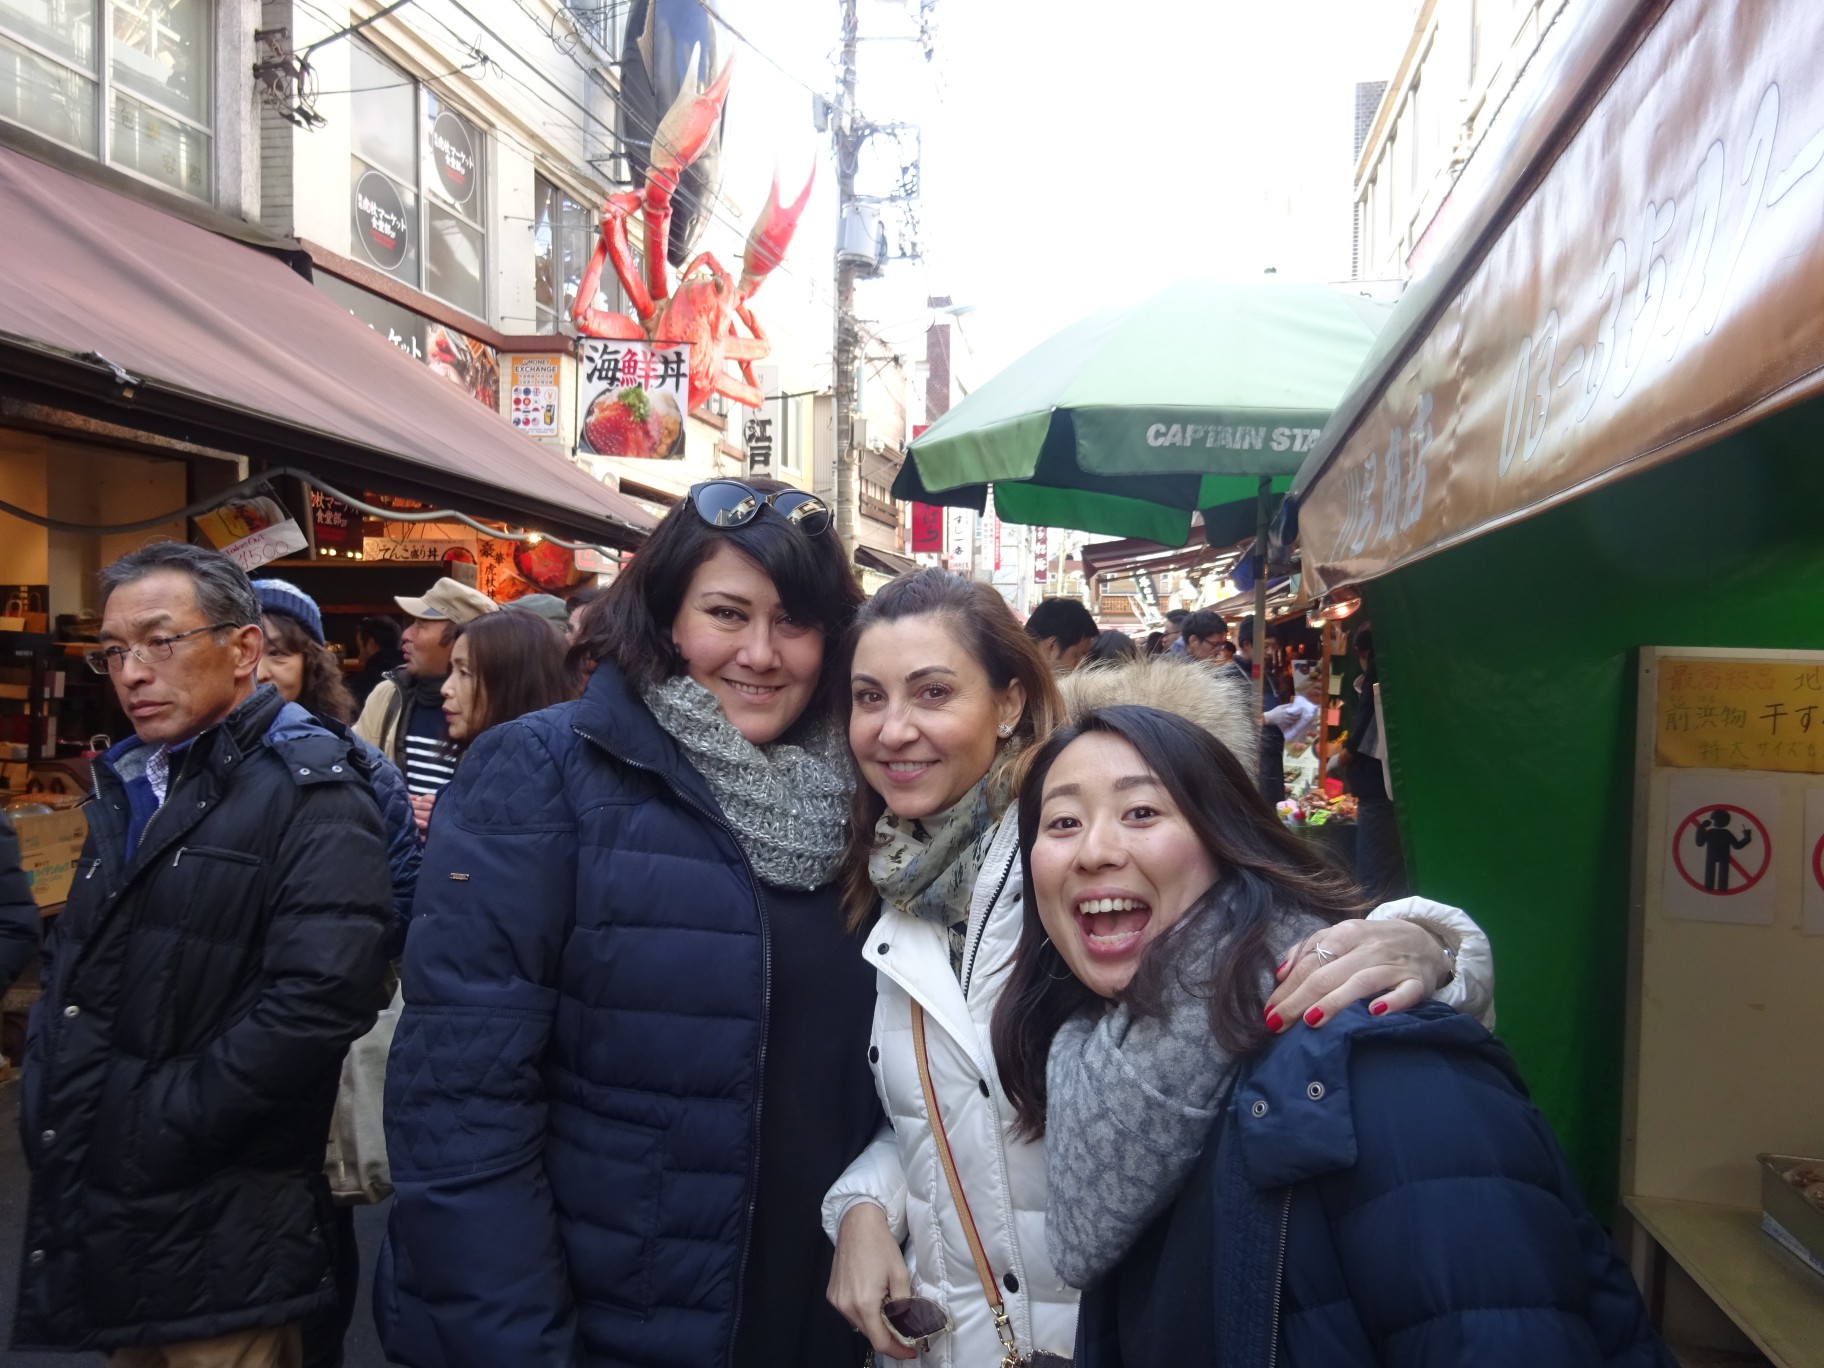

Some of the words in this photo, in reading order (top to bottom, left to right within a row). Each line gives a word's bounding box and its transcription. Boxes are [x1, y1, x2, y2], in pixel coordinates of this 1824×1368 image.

[585, 343, 688, 394] 海鮮丼
[1147, 423, 1267, 450] CAPTAIN
